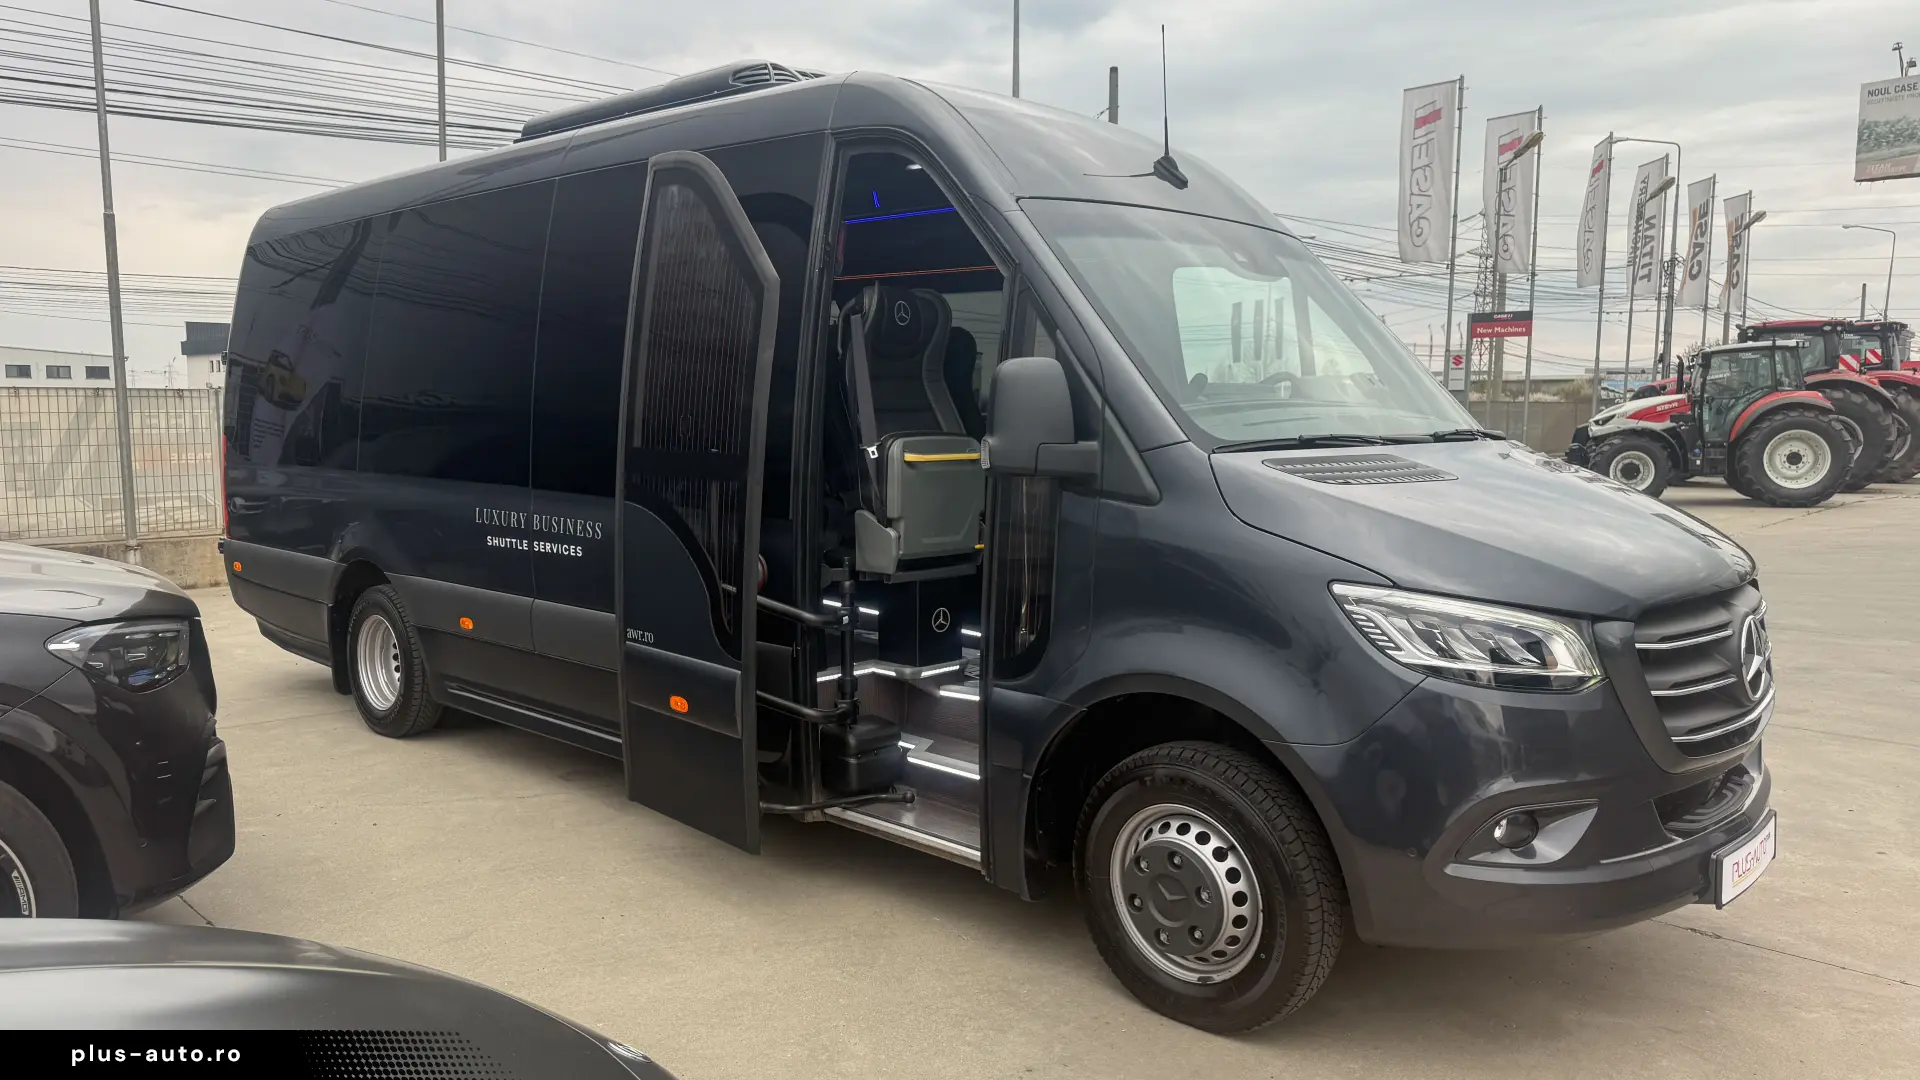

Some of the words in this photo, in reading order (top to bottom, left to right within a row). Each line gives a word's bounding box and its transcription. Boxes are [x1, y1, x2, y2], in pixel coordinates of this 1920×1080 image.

[1867, 86, 1891, 98] NOUL
[1894, 82, 1918, 94] CASE
[1494, 326, 1526, 334] Machines
[1656, 402, 1679, 411] STEYR
[475, 507, 527, 529] LUXURY
[533, 514, 603, 539] BUSINESS
[486, 535, 529, 551] SHUTTLE
[533, 541, 583, 557] SERVICES
[626, 627, 654, 643] awr.ro
